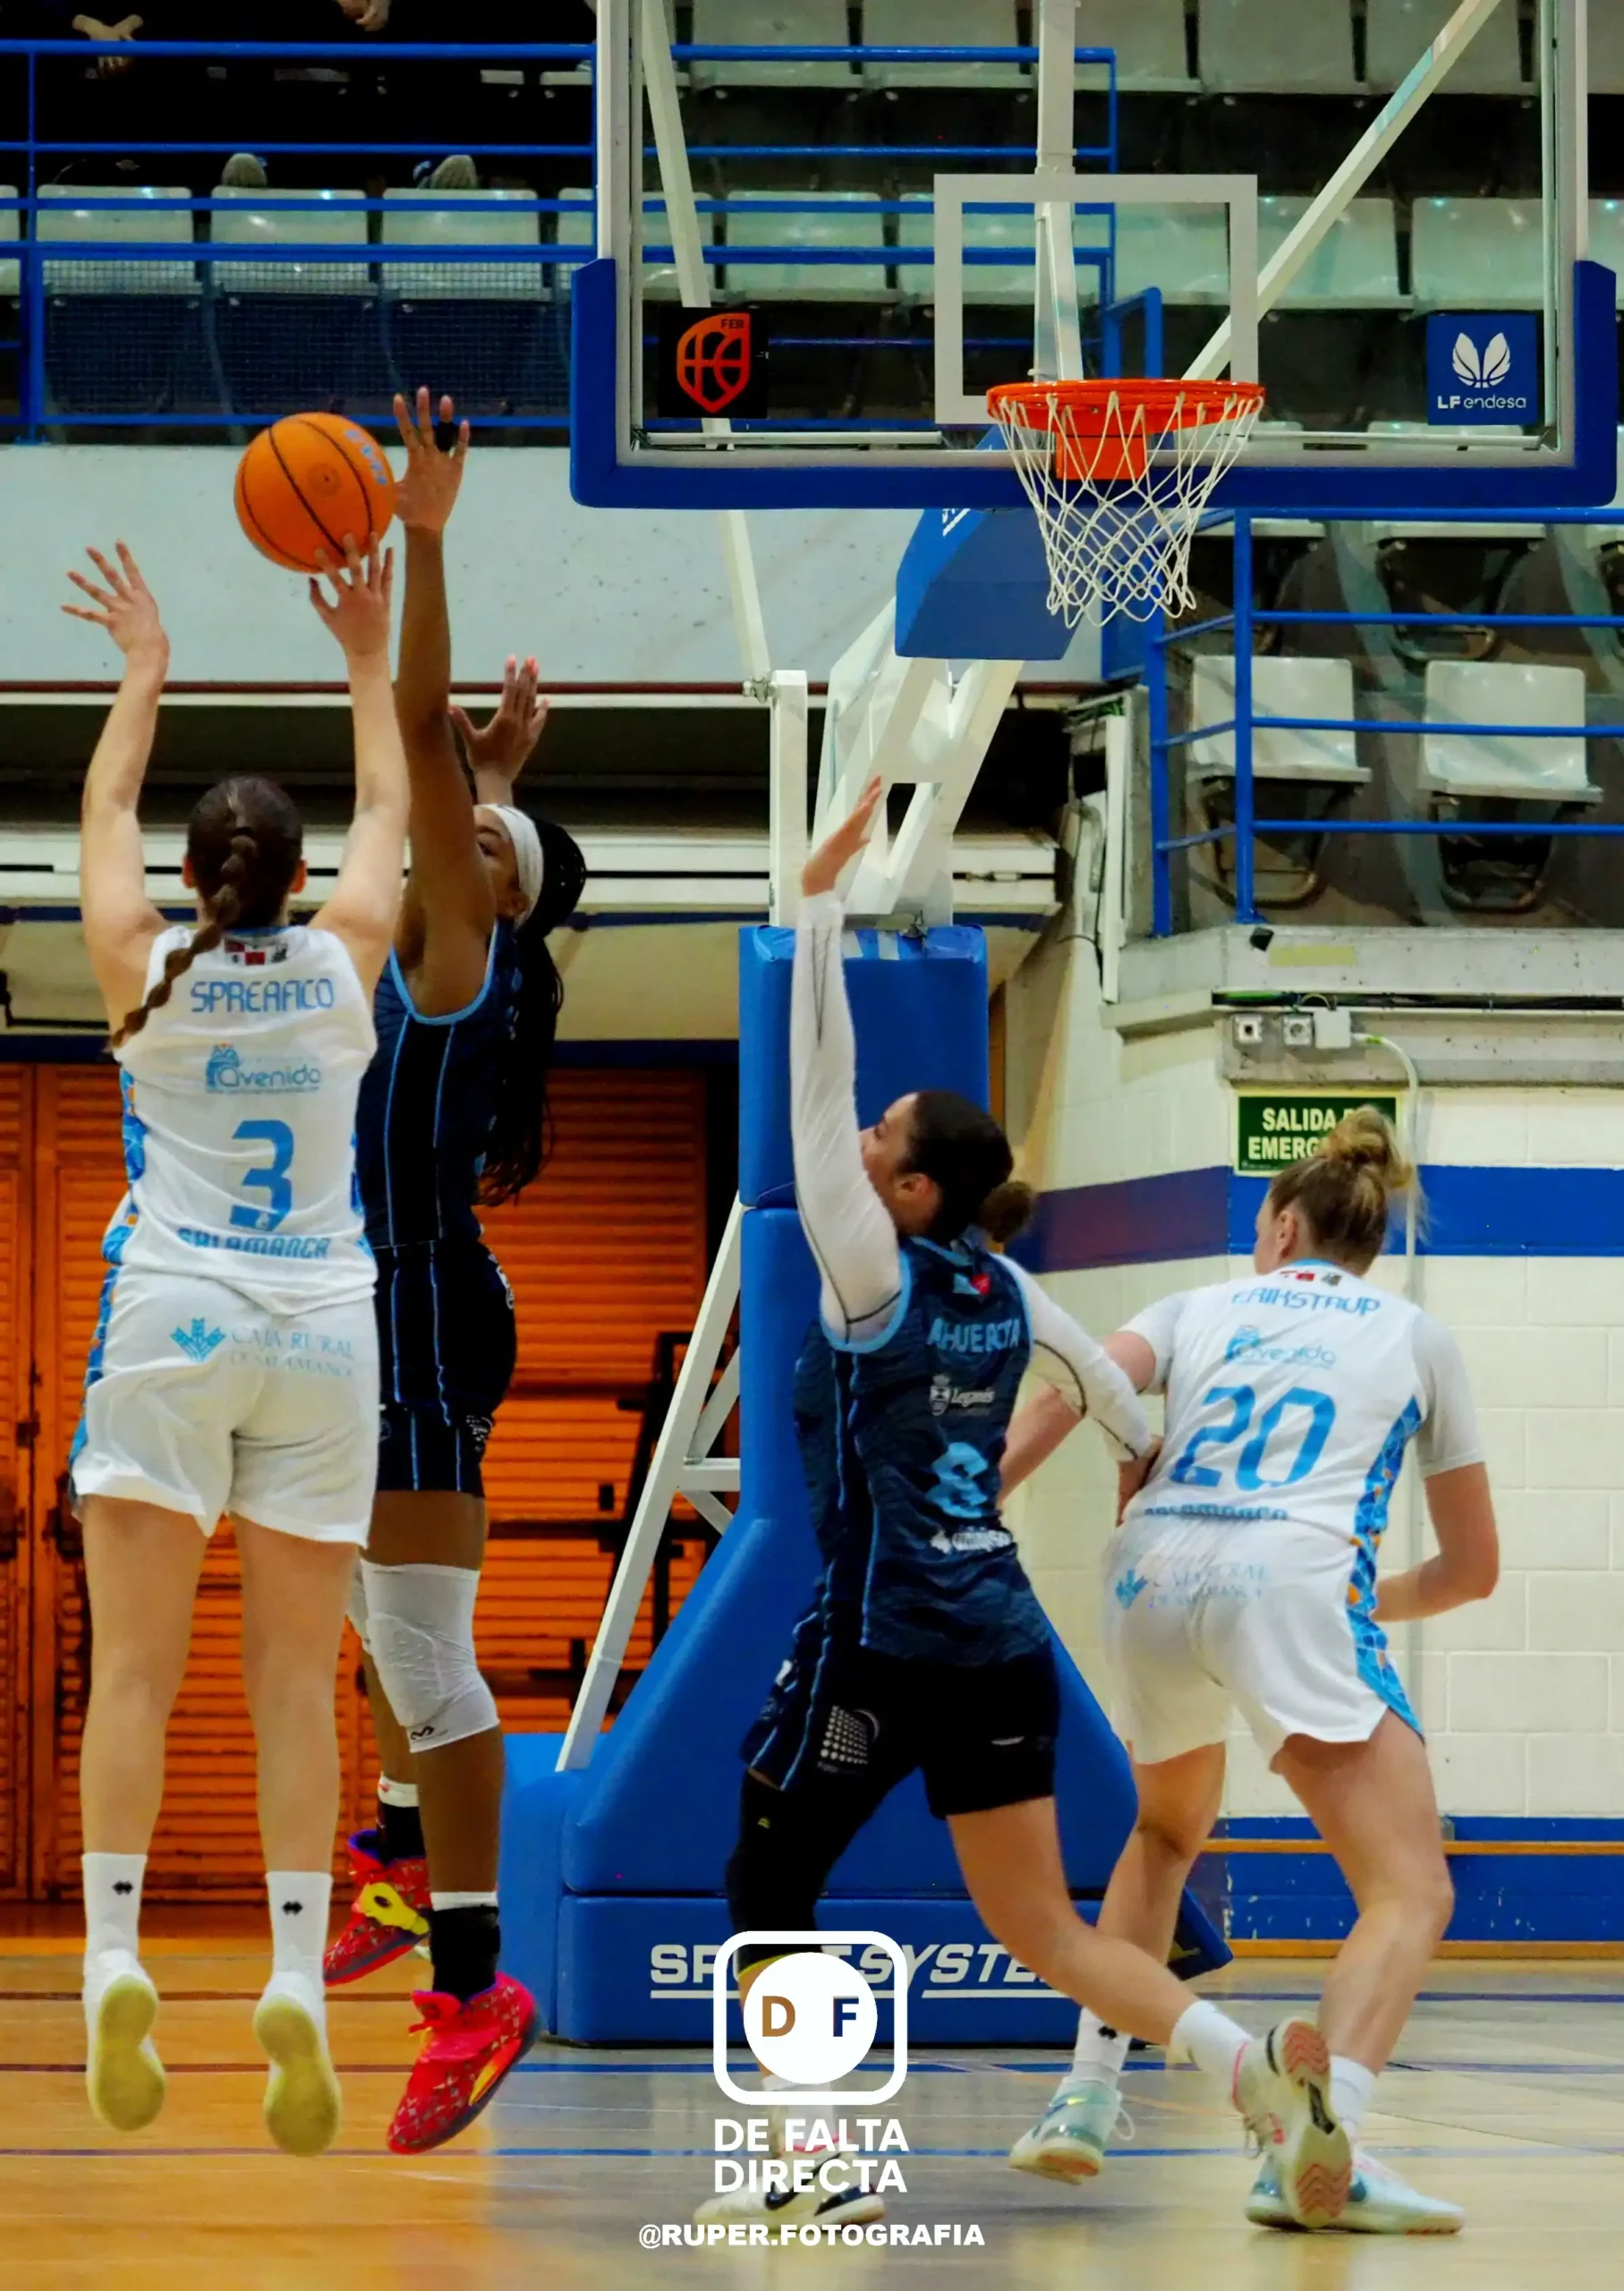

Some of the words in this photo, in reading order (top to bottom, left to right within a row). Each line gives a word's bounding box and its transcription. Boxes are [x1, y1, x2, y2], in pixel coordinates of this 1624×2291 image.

[1437, 396, 1461, 409] LF
[1463, 395, 1526, 409] endesa
[190, 978, 335, 1013] SPREAFICO
[1262, 1108, 1336, 1131] SALIDA
[230, 1120, 294, 1231] 3
[1169, 1384, 1337, 1491] 20
[925, 1442, 989, 1519] 8
